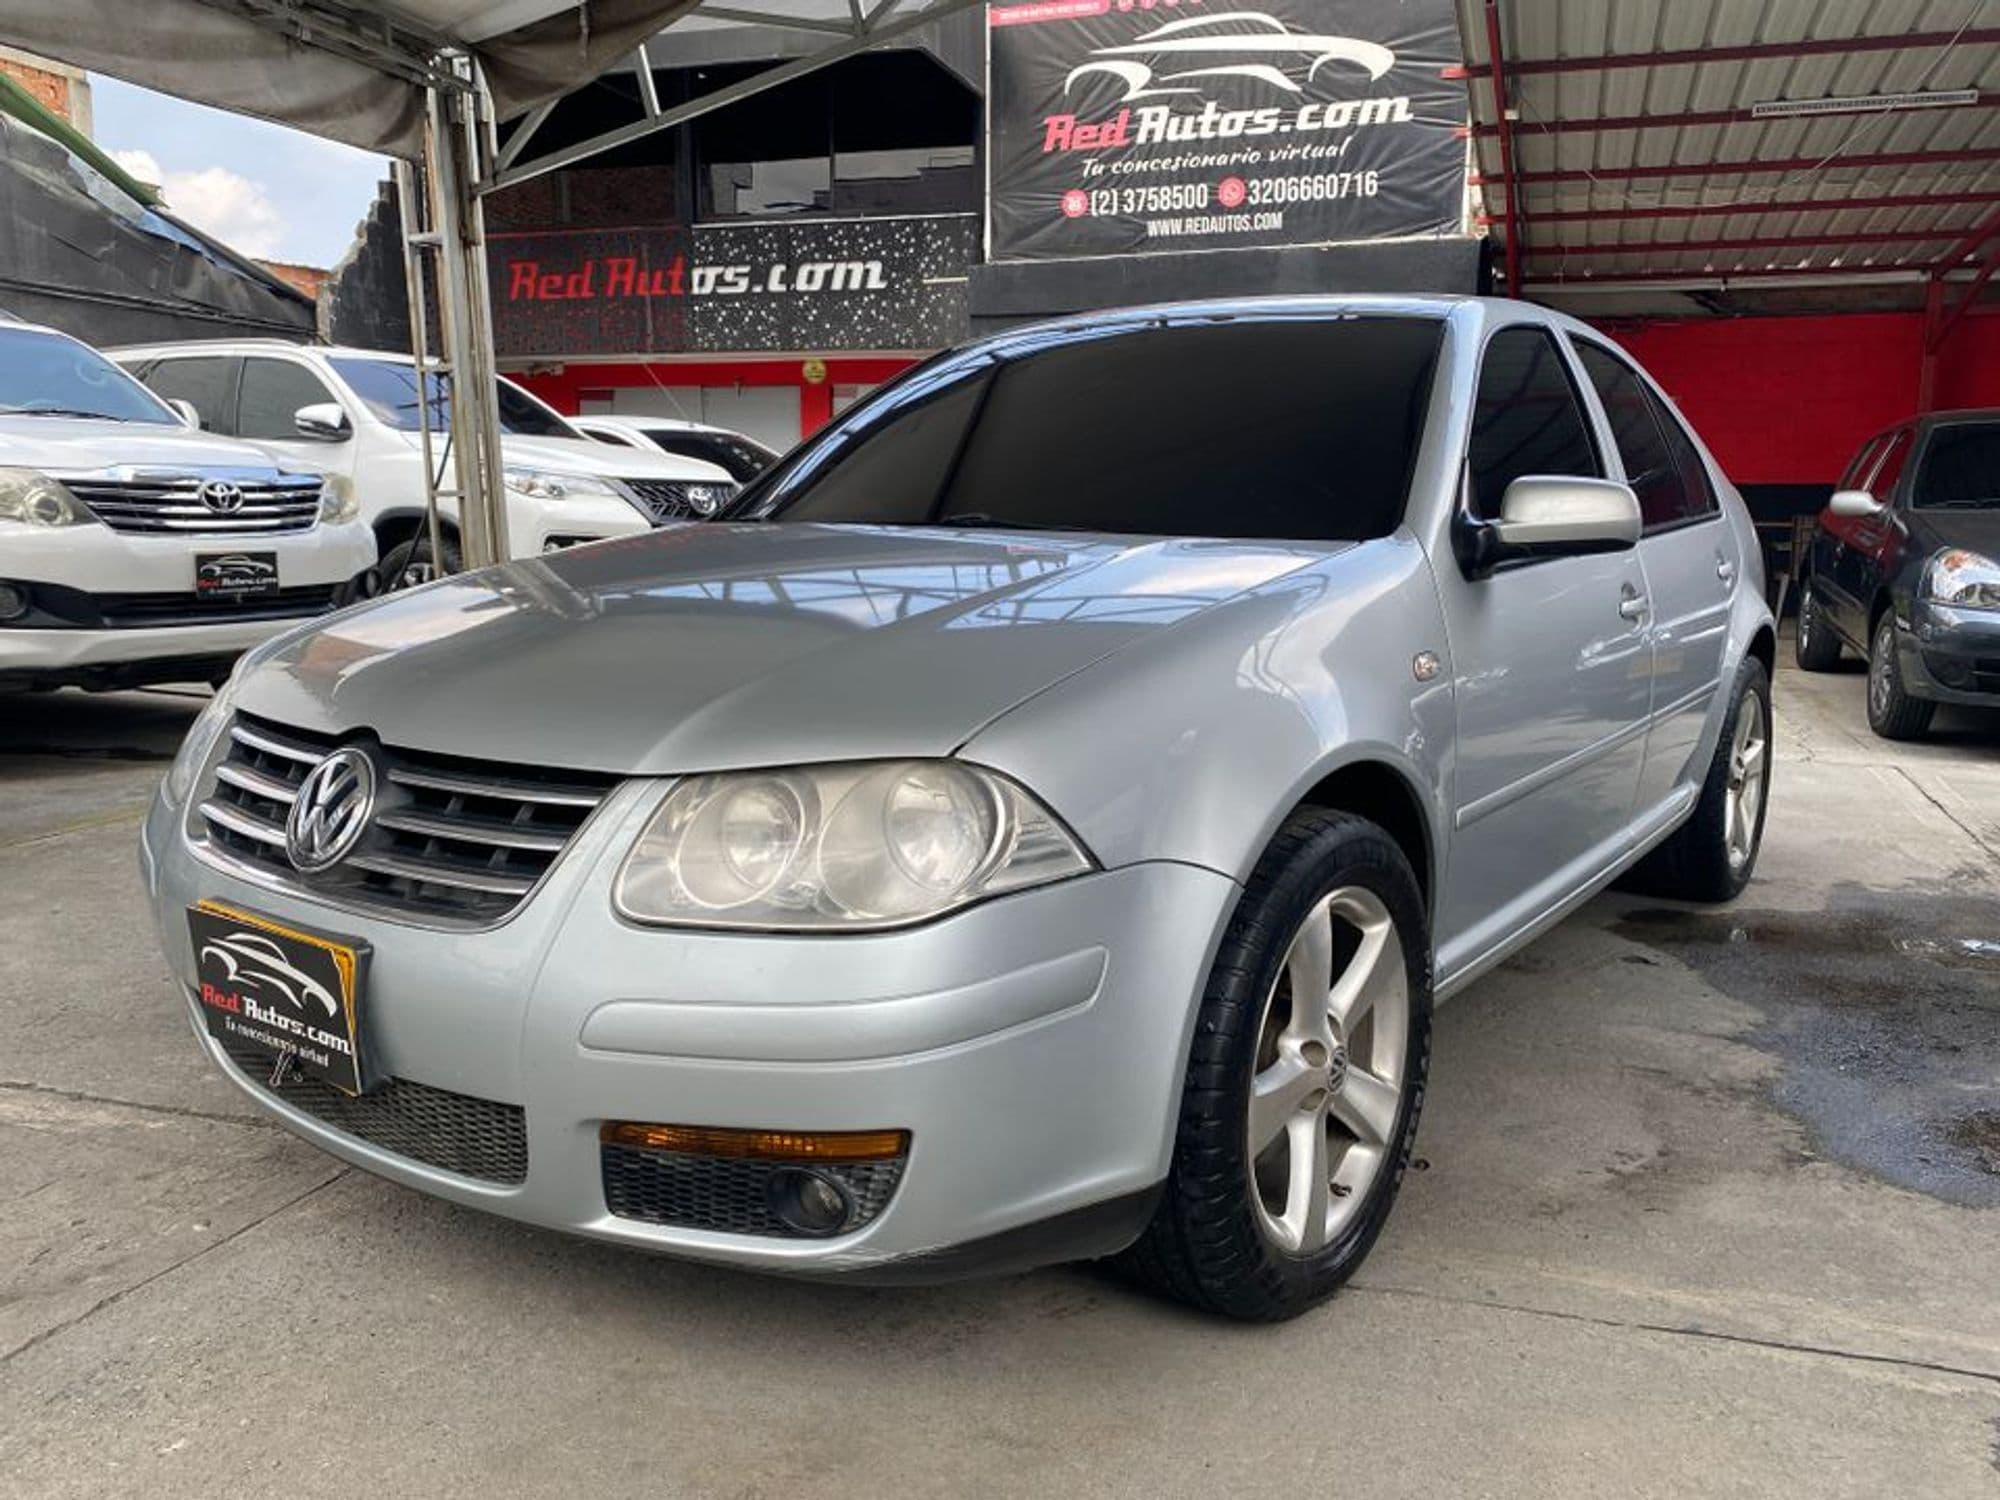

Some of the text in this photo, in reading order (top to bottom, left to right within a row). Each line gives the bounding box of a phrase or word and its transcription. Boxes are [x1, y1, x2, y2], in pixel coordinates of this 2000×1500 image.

[1043, 96, 1414, 152] Red Autos.com
[1081, 135, 1353, 178] Tu concesionario virtual
[1091, 183, 1208, 216] (2) 3758500
[1249, 170, 1379, 205] 3206660716
[1146, 211, 1284, 237] WWW.REDAUTOS.COM
[509, 254, 888, 300] Red Autos.com
[202, 983, 241, 1014] Red
[242, 995, 353, 1056] Autos.com
